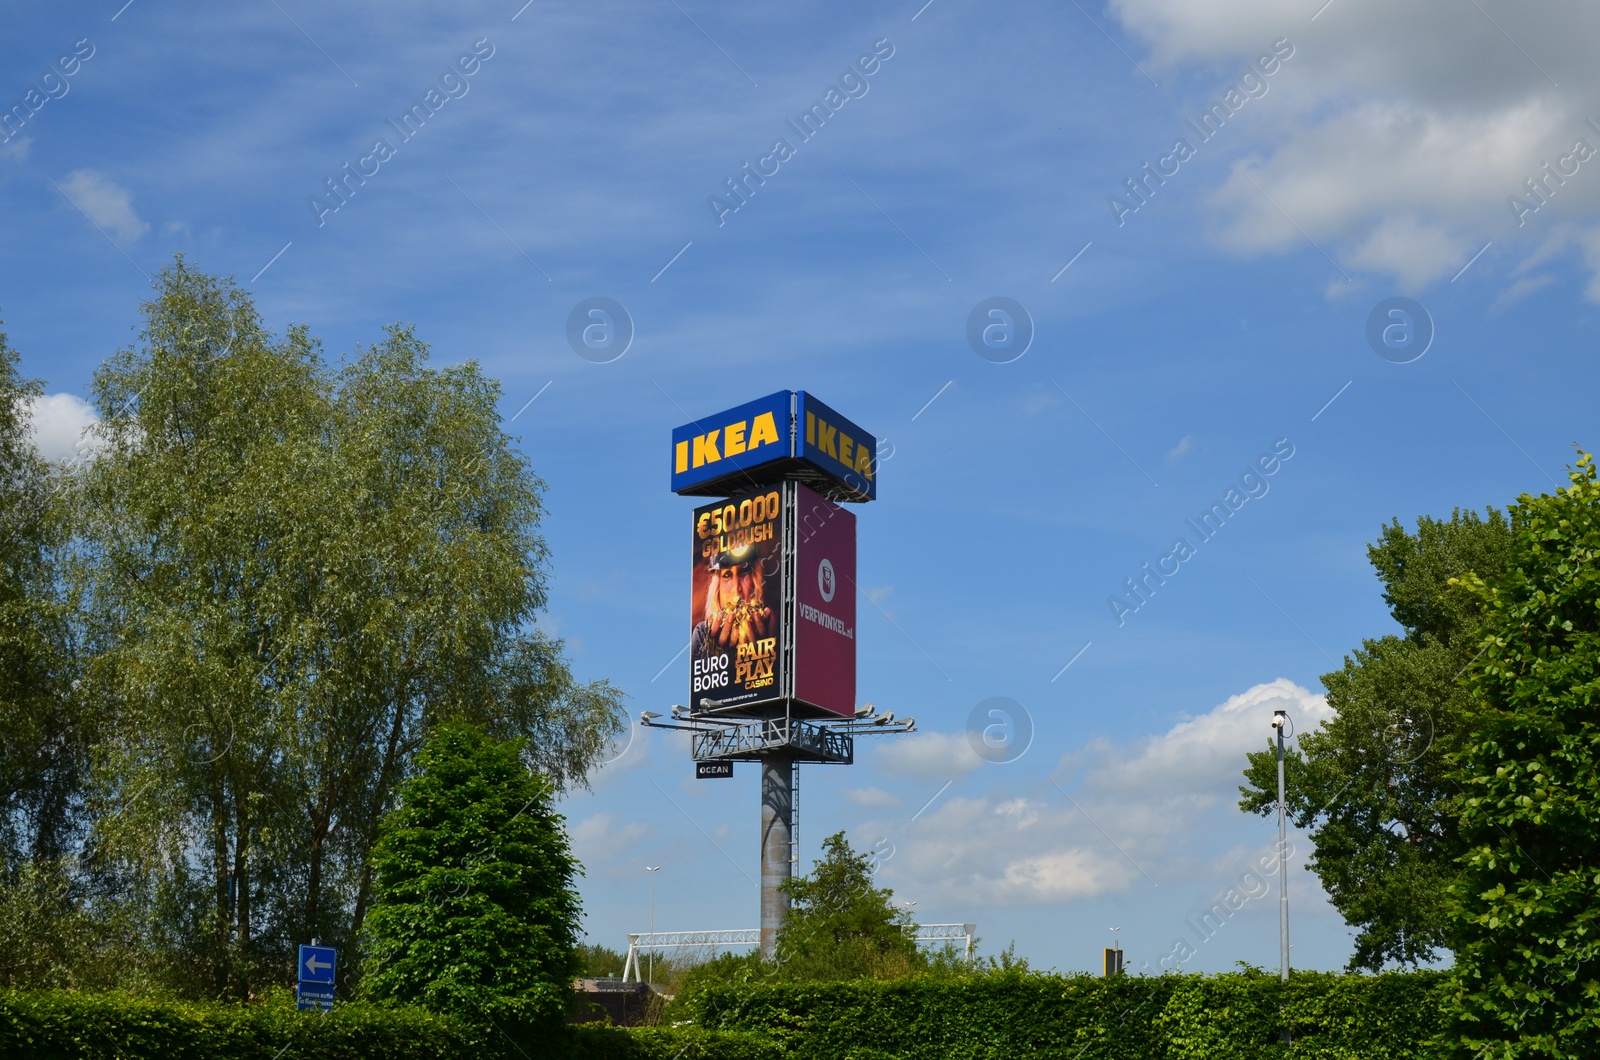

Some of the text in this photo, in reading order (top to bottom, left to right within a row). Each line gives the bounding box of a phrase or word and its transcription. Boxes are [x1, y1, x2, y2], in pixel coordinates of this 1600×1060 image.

[675, 411, 779, 474] IKEA
[806, 410, 873, 481] IKEA
[697, 491, 779, 539] €50.000
[702, 522, 773, 557] GOLDRUSH
[799, 602, 853, 639] VERFWINKEL.nl
[736, 637, 777, 663] FAIR
[694, 653, 729, 676] EURO
[734, 657, 775, 684] PLAY
[693, 670, 729, 692] BORG
[745, 677, 774, 690] CASINO
[699, 766, 729, 774] OCEAN
